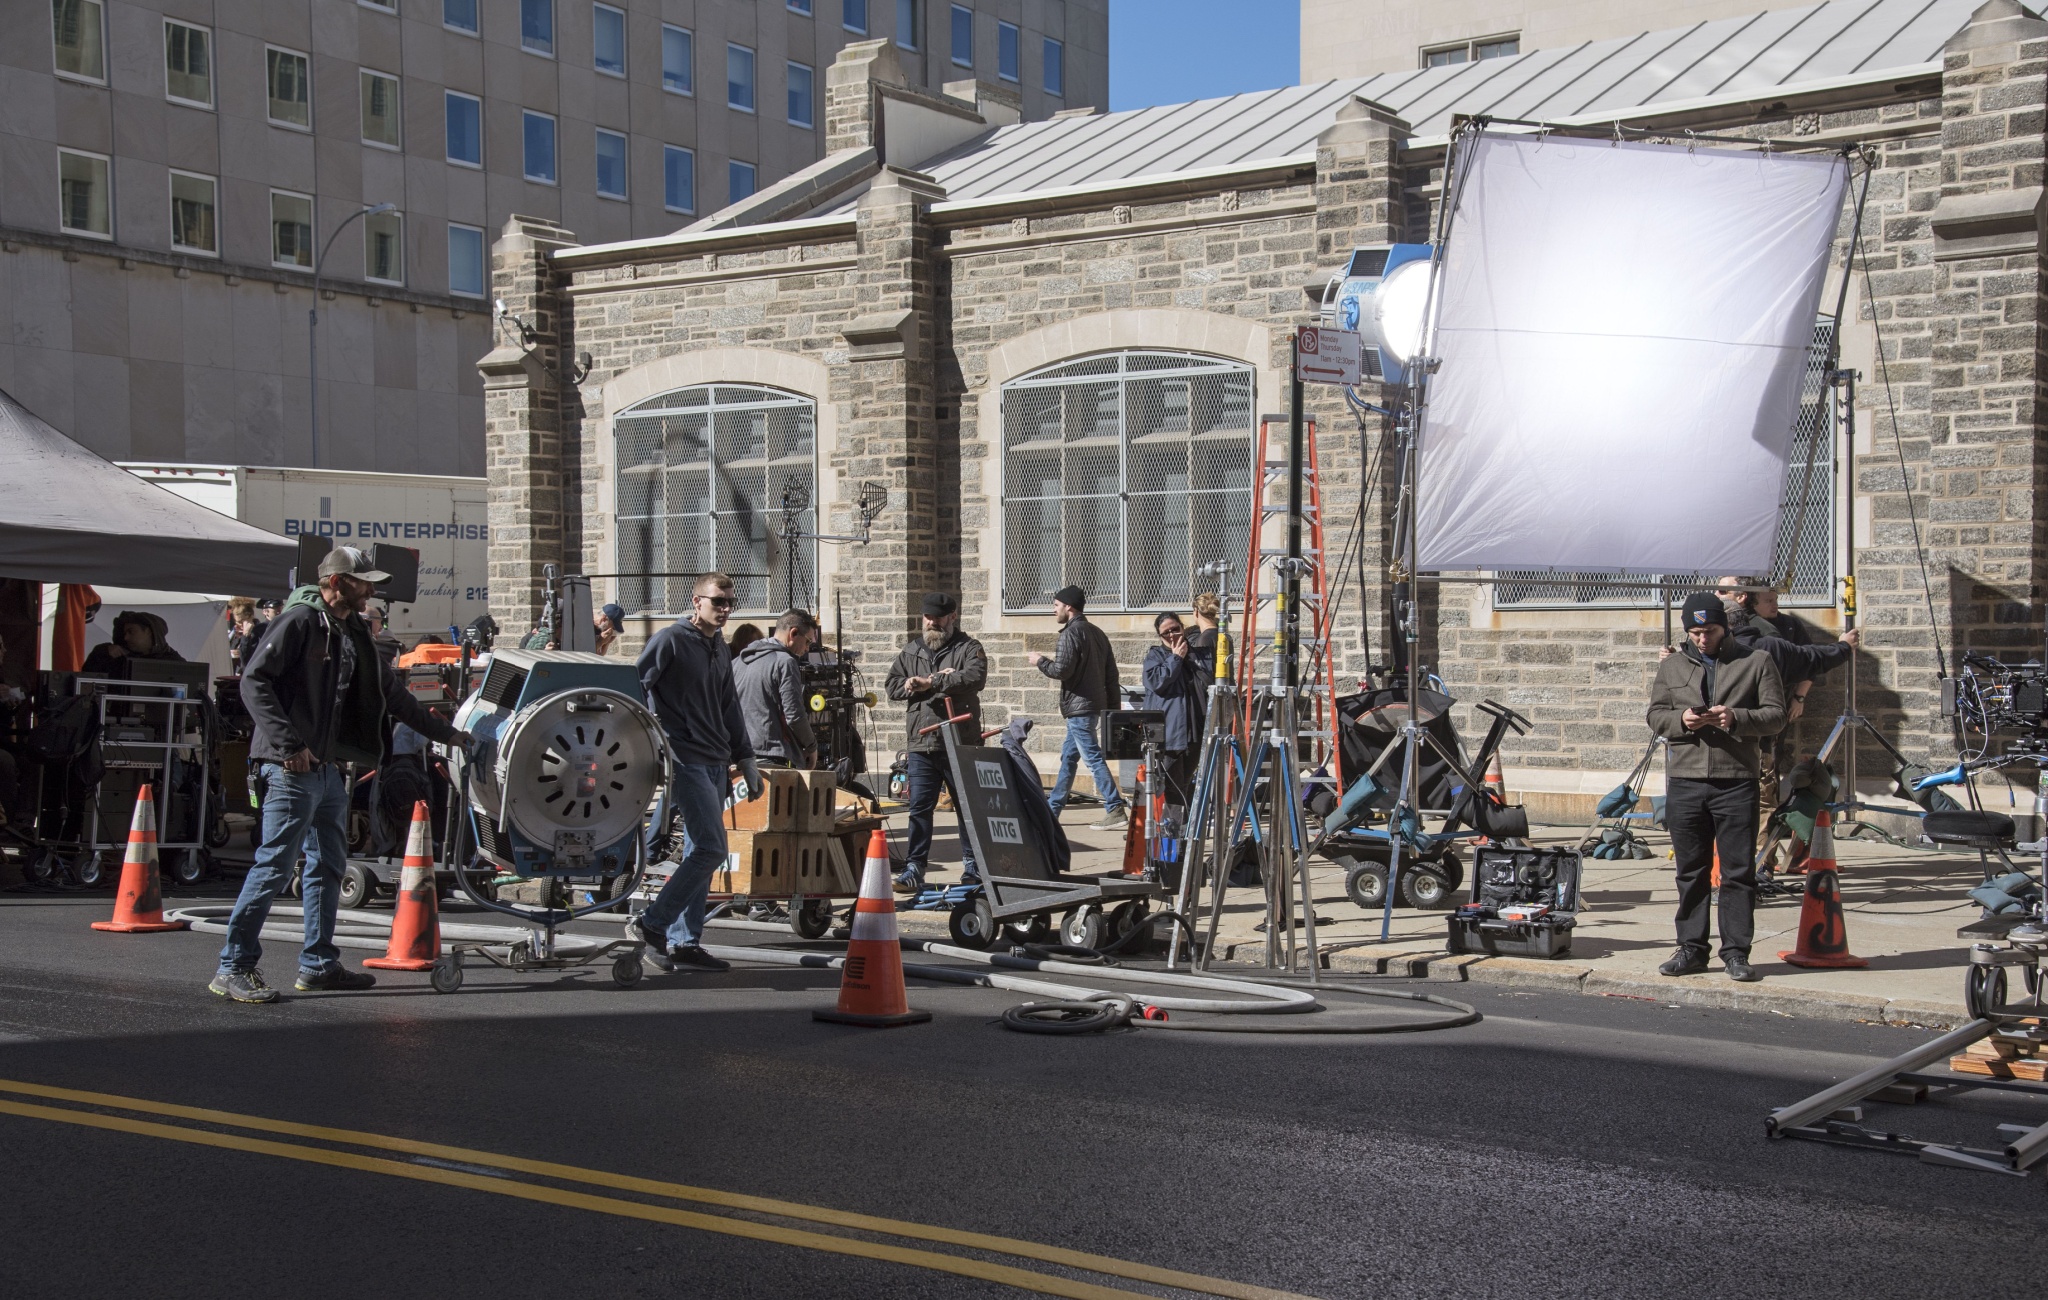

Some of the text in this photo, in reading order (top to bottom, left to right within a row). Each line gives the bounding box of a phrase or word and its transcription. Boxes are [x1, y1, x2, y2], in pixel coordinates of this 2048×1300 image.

[1320, 334, 1338, 345] Monday
[1320, 343, 1342, 353] Thursday
[1335, 356, 1356, 365] 12:30pm
[285, 519, 488, 540] BUDD ENTERPRISE
[466, 587, 488, 600] 212
[977, 769, 1003, 786] MTG
[991, 820, 1017, 838] MTG
